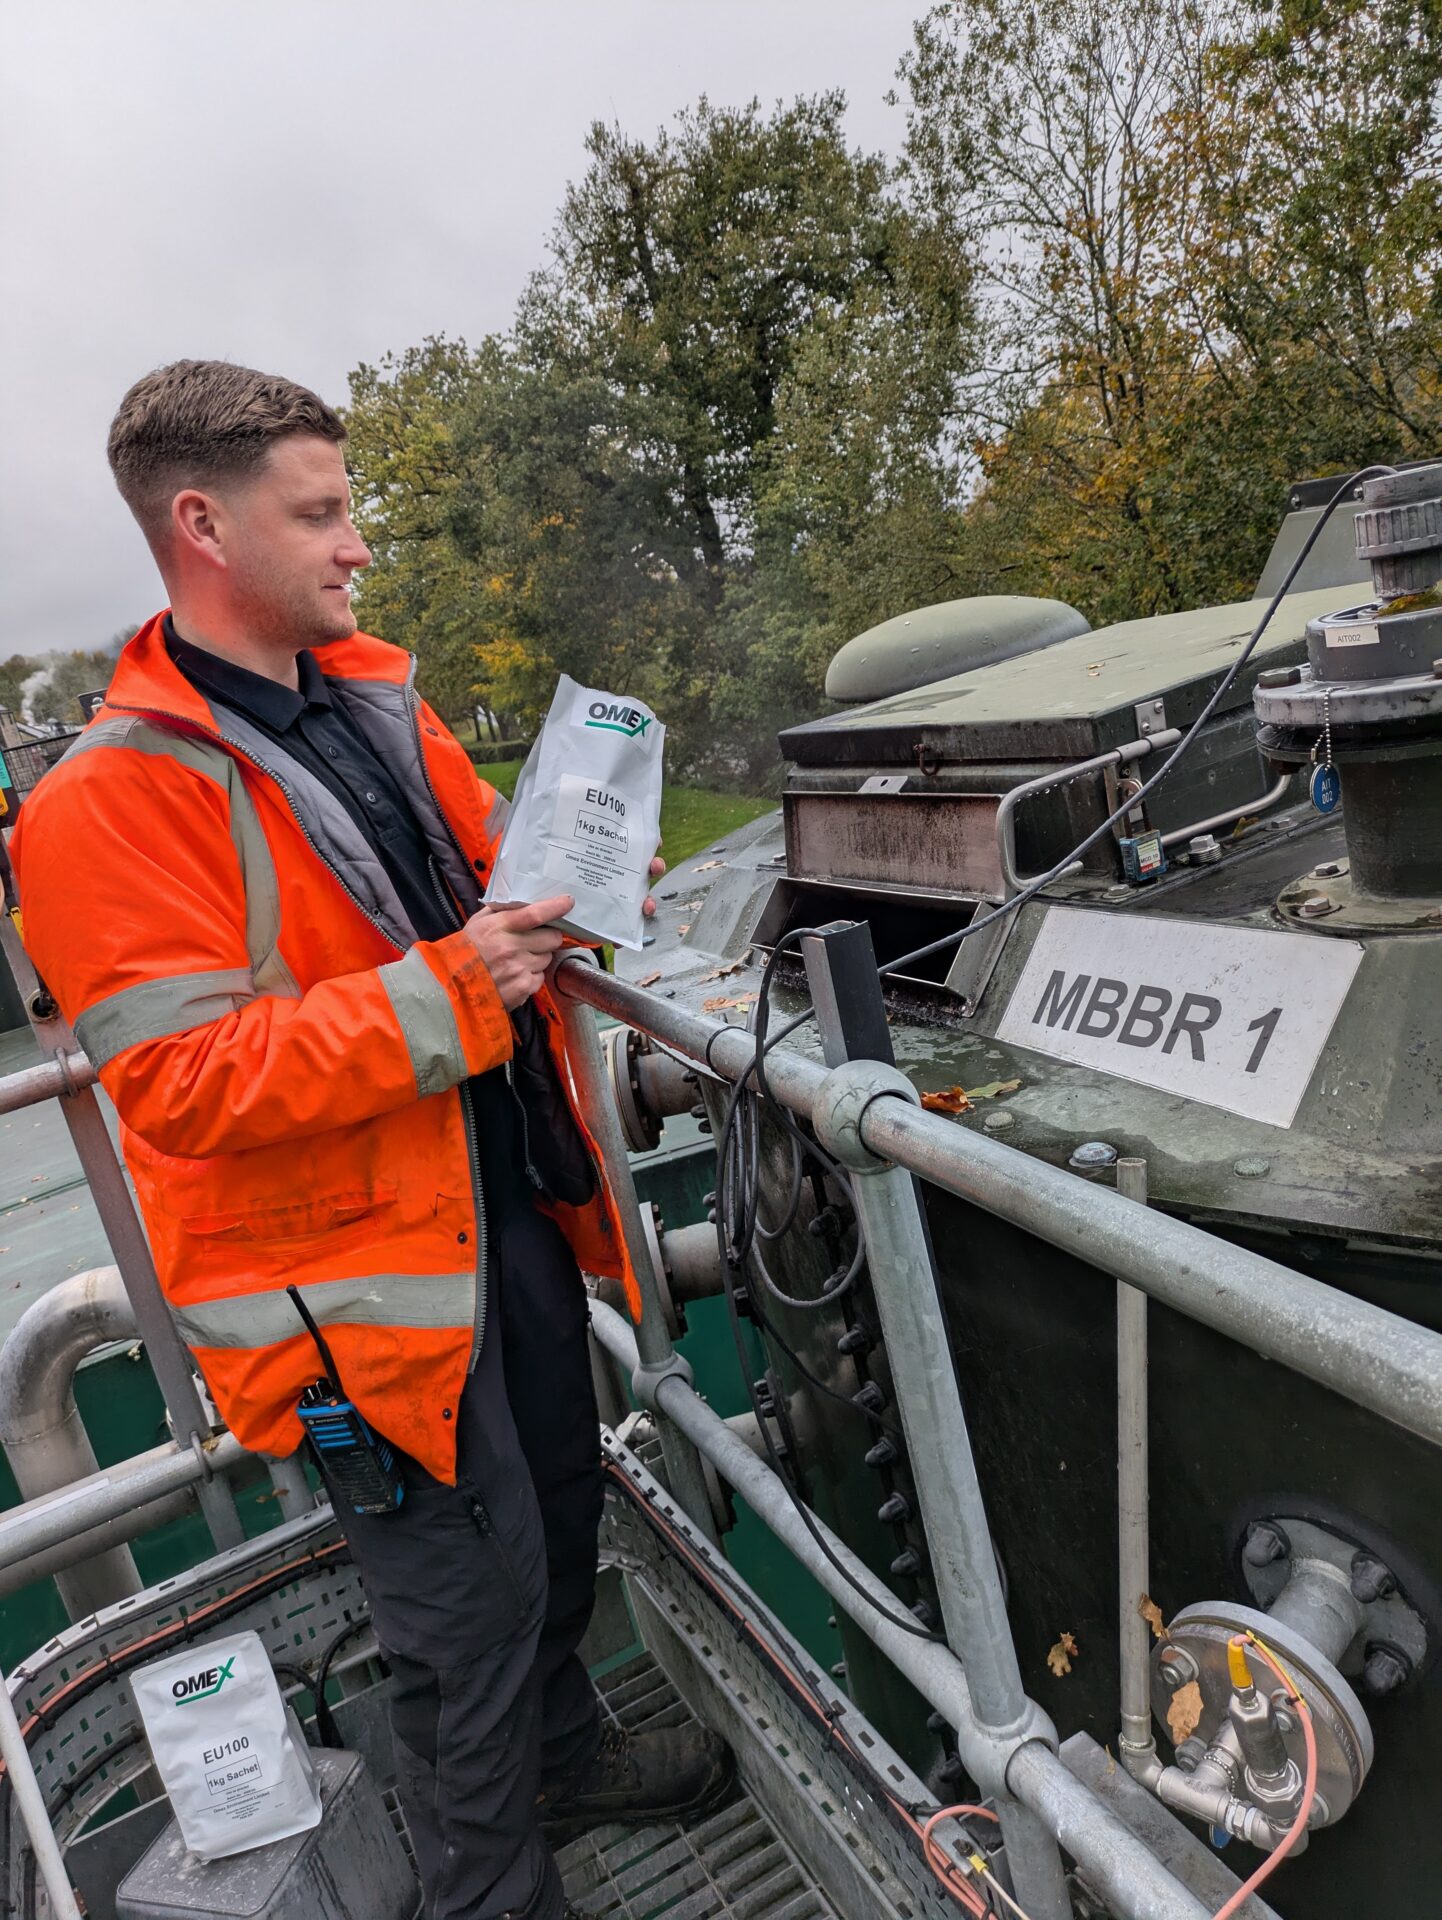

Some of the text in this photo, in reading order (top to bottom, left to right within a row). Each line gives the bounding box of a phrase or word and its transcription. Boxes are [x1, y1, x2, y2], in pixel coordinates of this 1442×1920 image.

[1337, 633, 1361, 643] AIT002
[588, 702, 653, 738] OMEX
[1321, 777, 1331, 792] AIT
[1321, 790, 1333, 805] 002
[585, 787, 626, 817] EU100
[577, 819, 627, 844] 1kg Sachet
[1032, 969, 1283, 1074] MBBR 1
[172, 1655, 236, 1698] OMEX
[203, 1735, 250, 1765] EU100
[208, 1762, 259, 1788] 1kg Sachet
